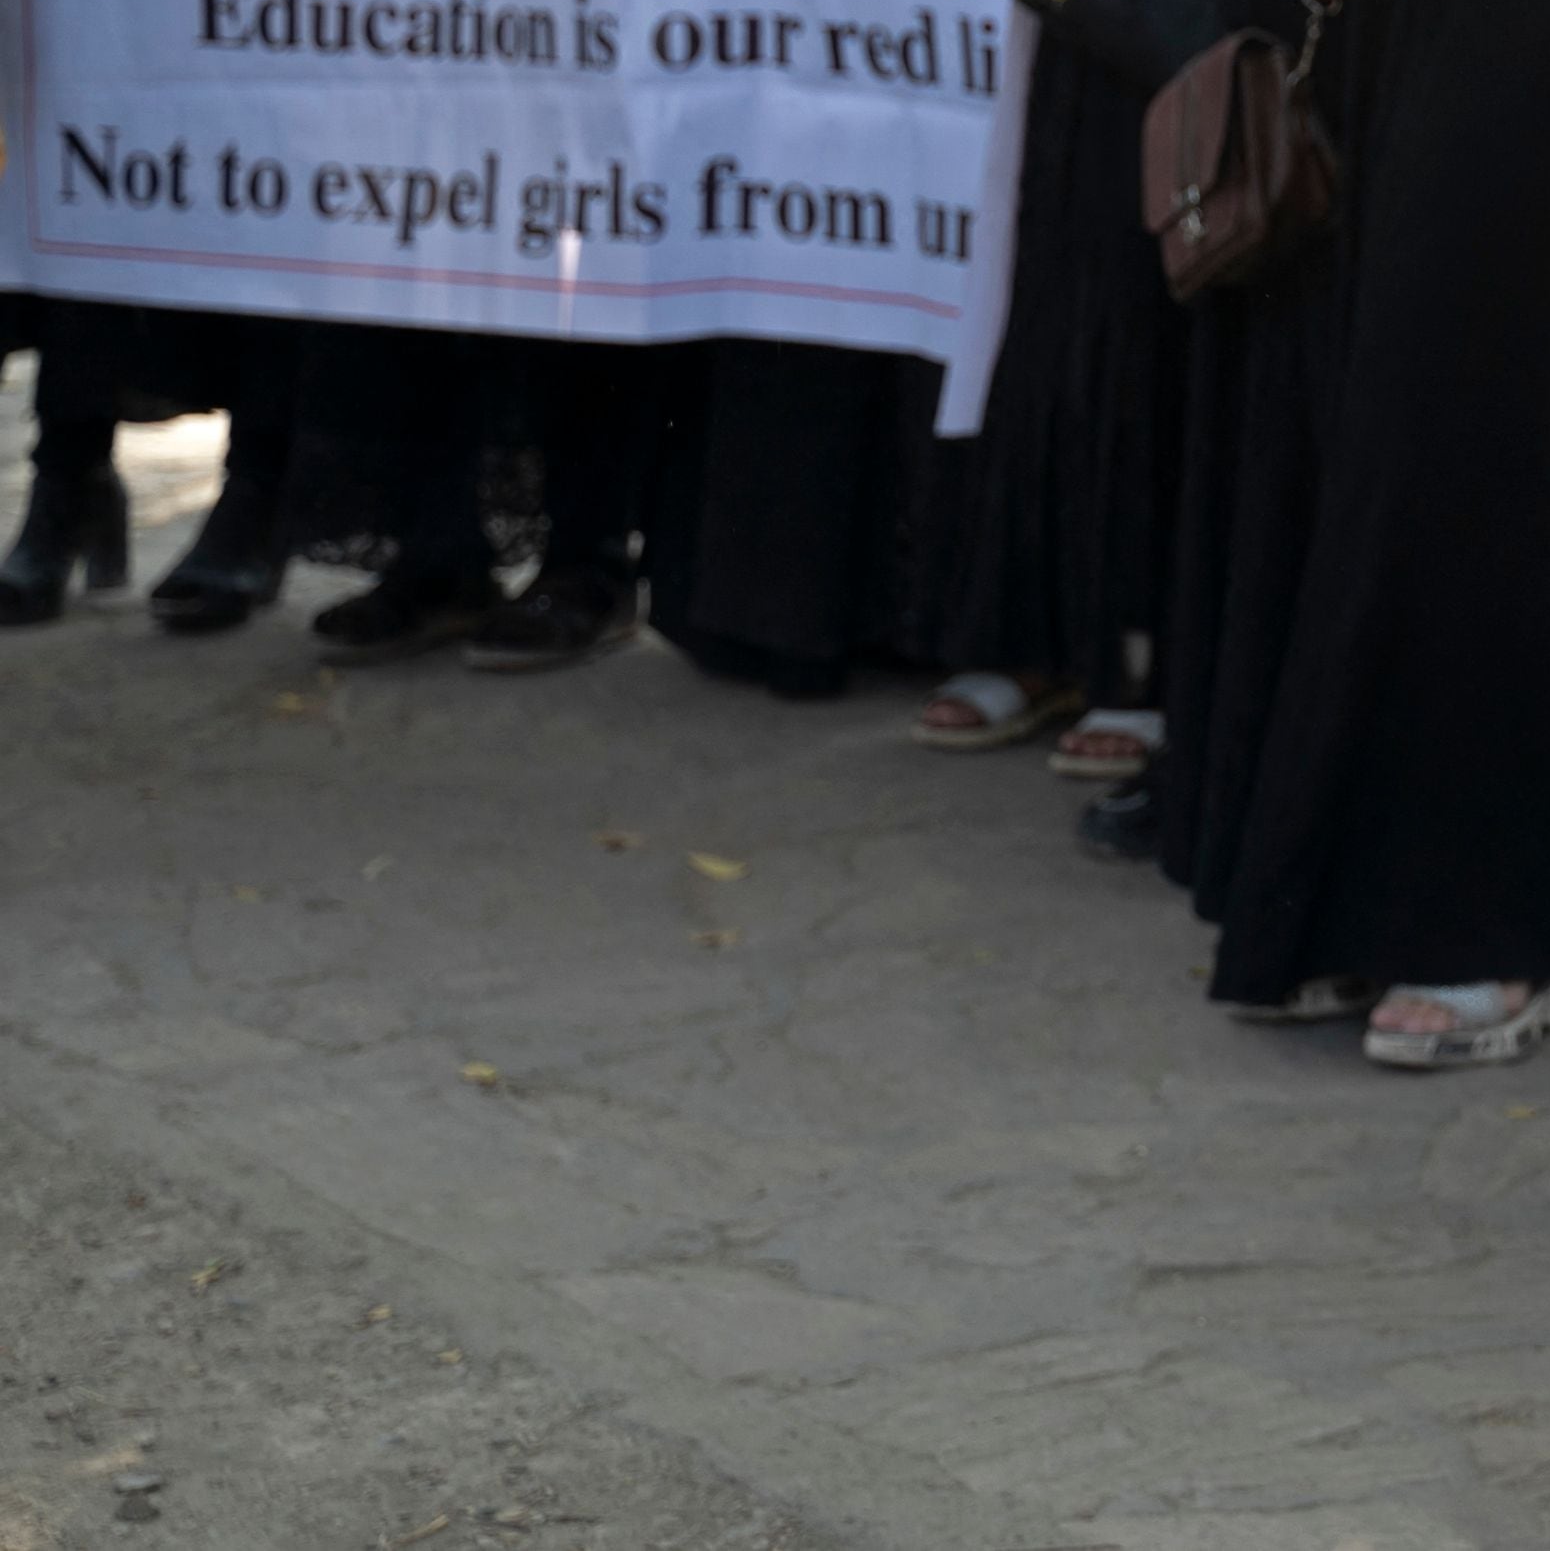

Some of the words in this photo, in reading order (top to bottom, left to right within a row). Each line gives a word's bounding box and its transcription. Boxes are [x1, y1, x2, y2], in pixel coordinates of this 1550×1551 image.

[651, 12, 804, 70] our
[822, 8, 940, 87] red
[957, 13, 999, 99] li
[59, 124, 190, 212] Not
[217, 146, 289, 214] to
[310, 152, 501, 248] expel
[519, 160, 668, 253] girls
[698, 157, 894, 249] from
